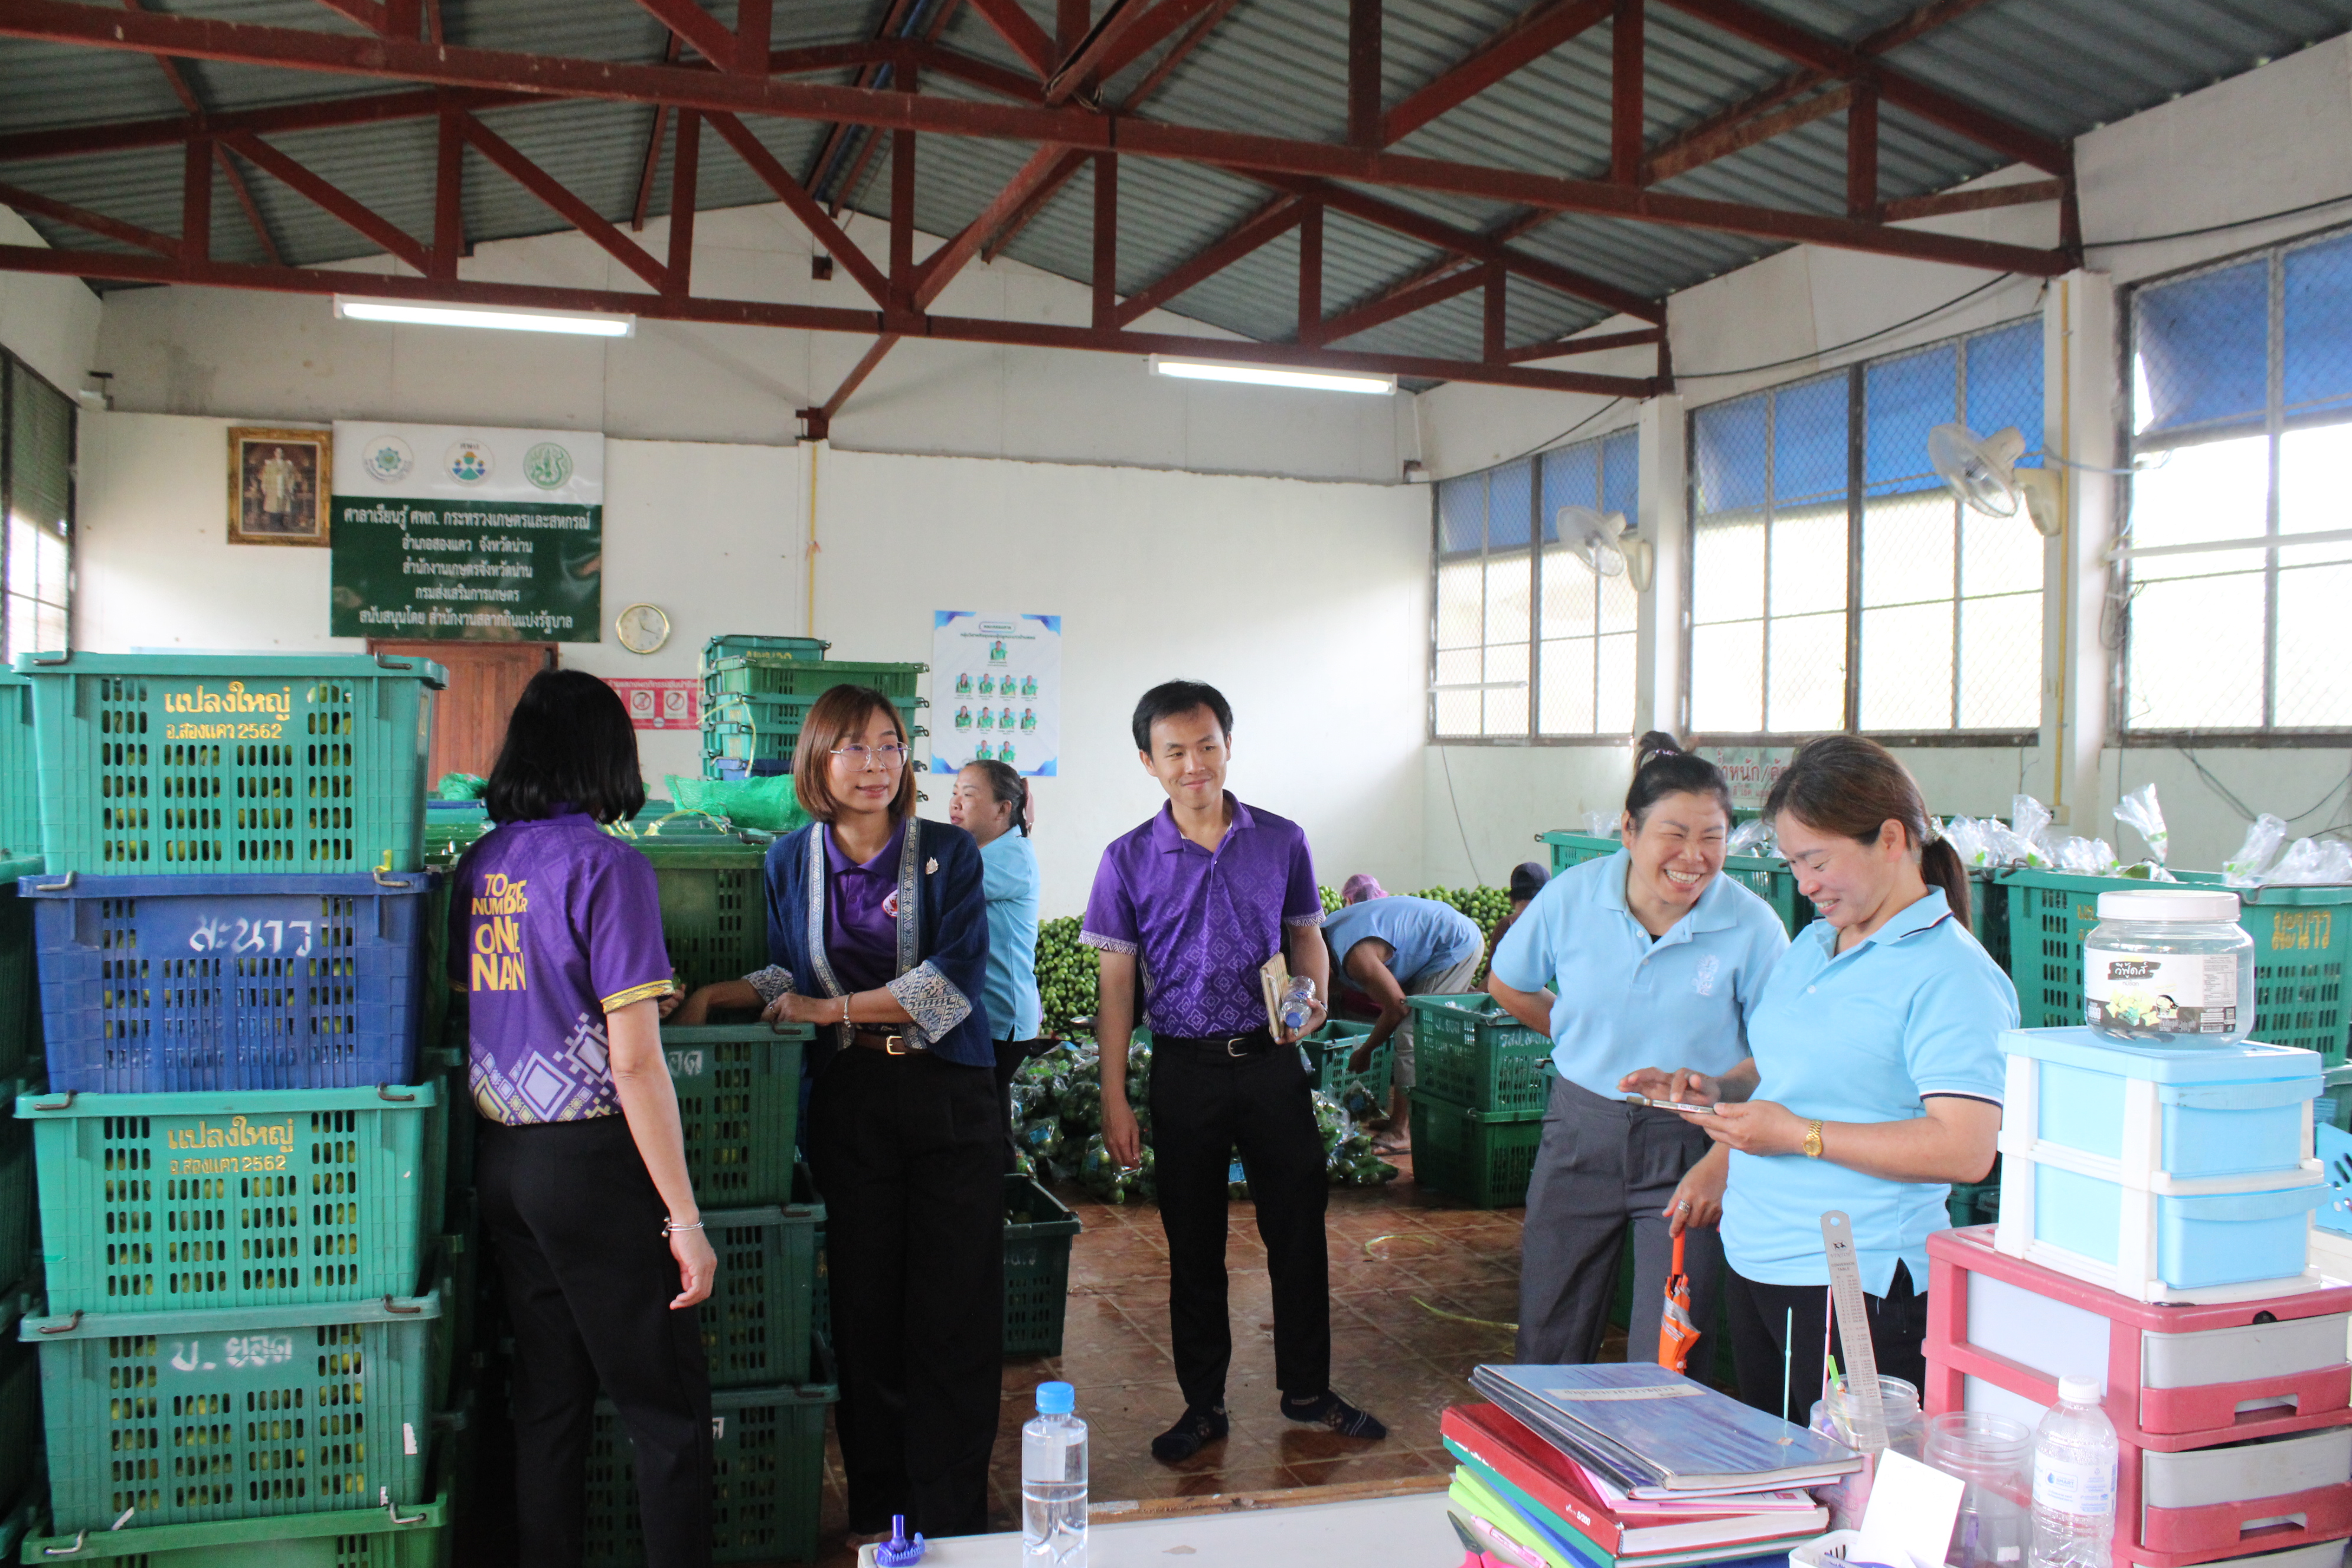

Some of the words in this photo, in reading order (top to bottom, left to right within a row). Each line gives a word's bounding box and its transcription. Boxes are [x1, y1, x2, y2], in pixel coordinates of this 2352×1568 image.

[344, 503, 410, 531] ศาลาเรียนรู้
[410, 511, 440, 525] ศพก.
[443, 511, 590, 530] กระทรวงเกษตรและสหกรณ์
[402, 533, 472, 551] อำเภอสองแคว
[479, 535, 533, 553] จังหวัดน่าน
[403, 556, 533, 579] สำนักงานเกษตรจังหวัดน่าน
[415, 583, 520, 602] กรมส่งเสริมการเกษตร
[359, 605, 426, 631] สนับสนุนโดย
[429, 606, 574, 634] สำนักงานสลากกินแบ่งรัฐบาล
[164, 681, 291, 721] แปลงใหญ่
[166, 723, 236, 739] อ.สองแคว
[237, 723, 283, 739] 2562
[484, 873, 509, 897] TO
[472, 896, 528, 916] NUMBER
[189, 915, 312, 958] มะนาว
[475, 915, 521, 955] ONE
[2271, 910, 2332, 950] มะนาว
[471, 952, 527, 991] NAN
[2113, 961, 2149, 979] วีฟู้ดส์
[167, 1115, 294, 1153] แปลงใหญ่
[170, 1156, 239, 1175] อ.สองแคว
[241, 1154, 286, 1172] 2562
